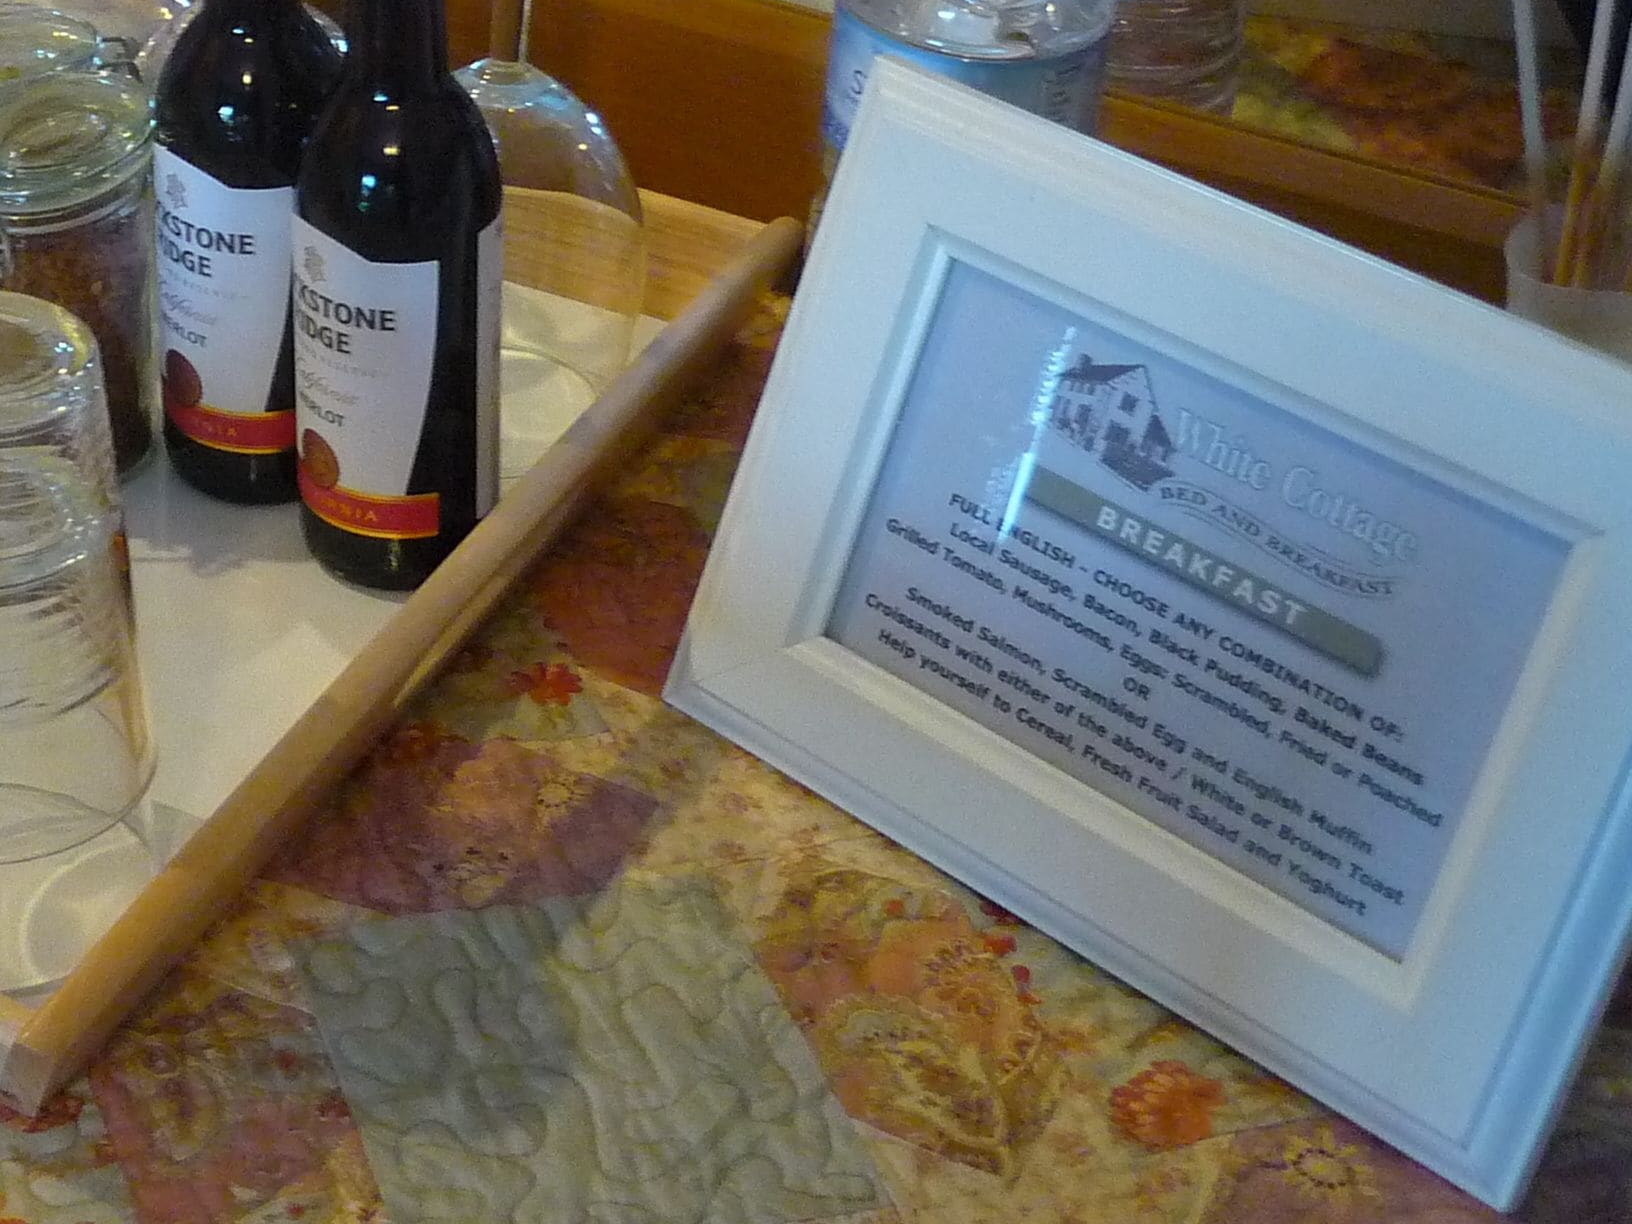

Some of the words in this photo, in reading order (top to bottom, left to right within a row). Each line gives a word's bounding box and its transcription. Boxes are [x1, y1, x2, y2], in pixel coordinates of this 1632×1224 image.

[948, 492, 991, 526] FULL
[1092, 568, 1170, 619] CHOOSE
[1172, 612, 1215, 640] ANY
[1218, 635, 1365, 721] COMBINATION
[1097, 505, 1308, 625] BREAKFAST
[1160, 485, 1207, 507] BED
[1211, 504, 1261, 537] AND
[1176, 406, 1269, 491] White
[1281, 465, 1420, 566] Cottage
[864, 592, 952, 651] Croissants
[954, 644, 994, 674] with
[996, 667, 1051, 705] either
[1053, 697, 1077, 718] of
[1077, 710, 1108, 738] the
[1111, 733, 1169, 773] above
[1190, 773, 1246, 817] White
[1250, 811, 1273, 829] or
[1277, 823, 1342, 870] Brown
[1349, 861, 1405, 906] Toast
[877, 628, 917, 660] Help
[918, 653, 991, 702] yourself
[993, 693, 1012, 715] to
[1015, 706, 1076, 754] Cereal,
[1080, 743, 1133, 784] Fresh
[1136, 775, 1183, 813] Fruit
[1185, 803, 1240, 844] Salad
[1242, 838, 1283, 867] and
[1288, 858, 1367, 917] Yoghurt
[885, 517, 939, 556] Grilled
[943, 546, 1008, 596] Tomato,
[1011, 583, 1115, 653] Mushrooms,
[1171, 672, 1273, 739] Scrambled,
[1278, 728, 1329, 767] Fried
[1331, 760, 1353, 778] or
[1357, 771, 1445, 828] Poached
[905, 586, 976, 634] Smoked
[976, 624, 1047, 676] Salmon,
[1050, 667, 1149, 730] Scrambled
[1151, 722, 1188, 755] Egg
[1191, 745, 1230, 775] and
[1232, 766, 1305, 817] English
[1308, 809, 1374, 856] Muffin
[950, 521, 996, 556] Local
[998, 547, 1077, 602] Sausage,
[1082, 593, 1142, 638] Bacon,
[1148, 627, 1200, 666] Black
[1203, 657, 1287, 716] Pudding,
[1293, 705, 1358, 750] Baked
[1362, 742, 1425, 786] Beans
[1122, 676, 1151, 702] OR
